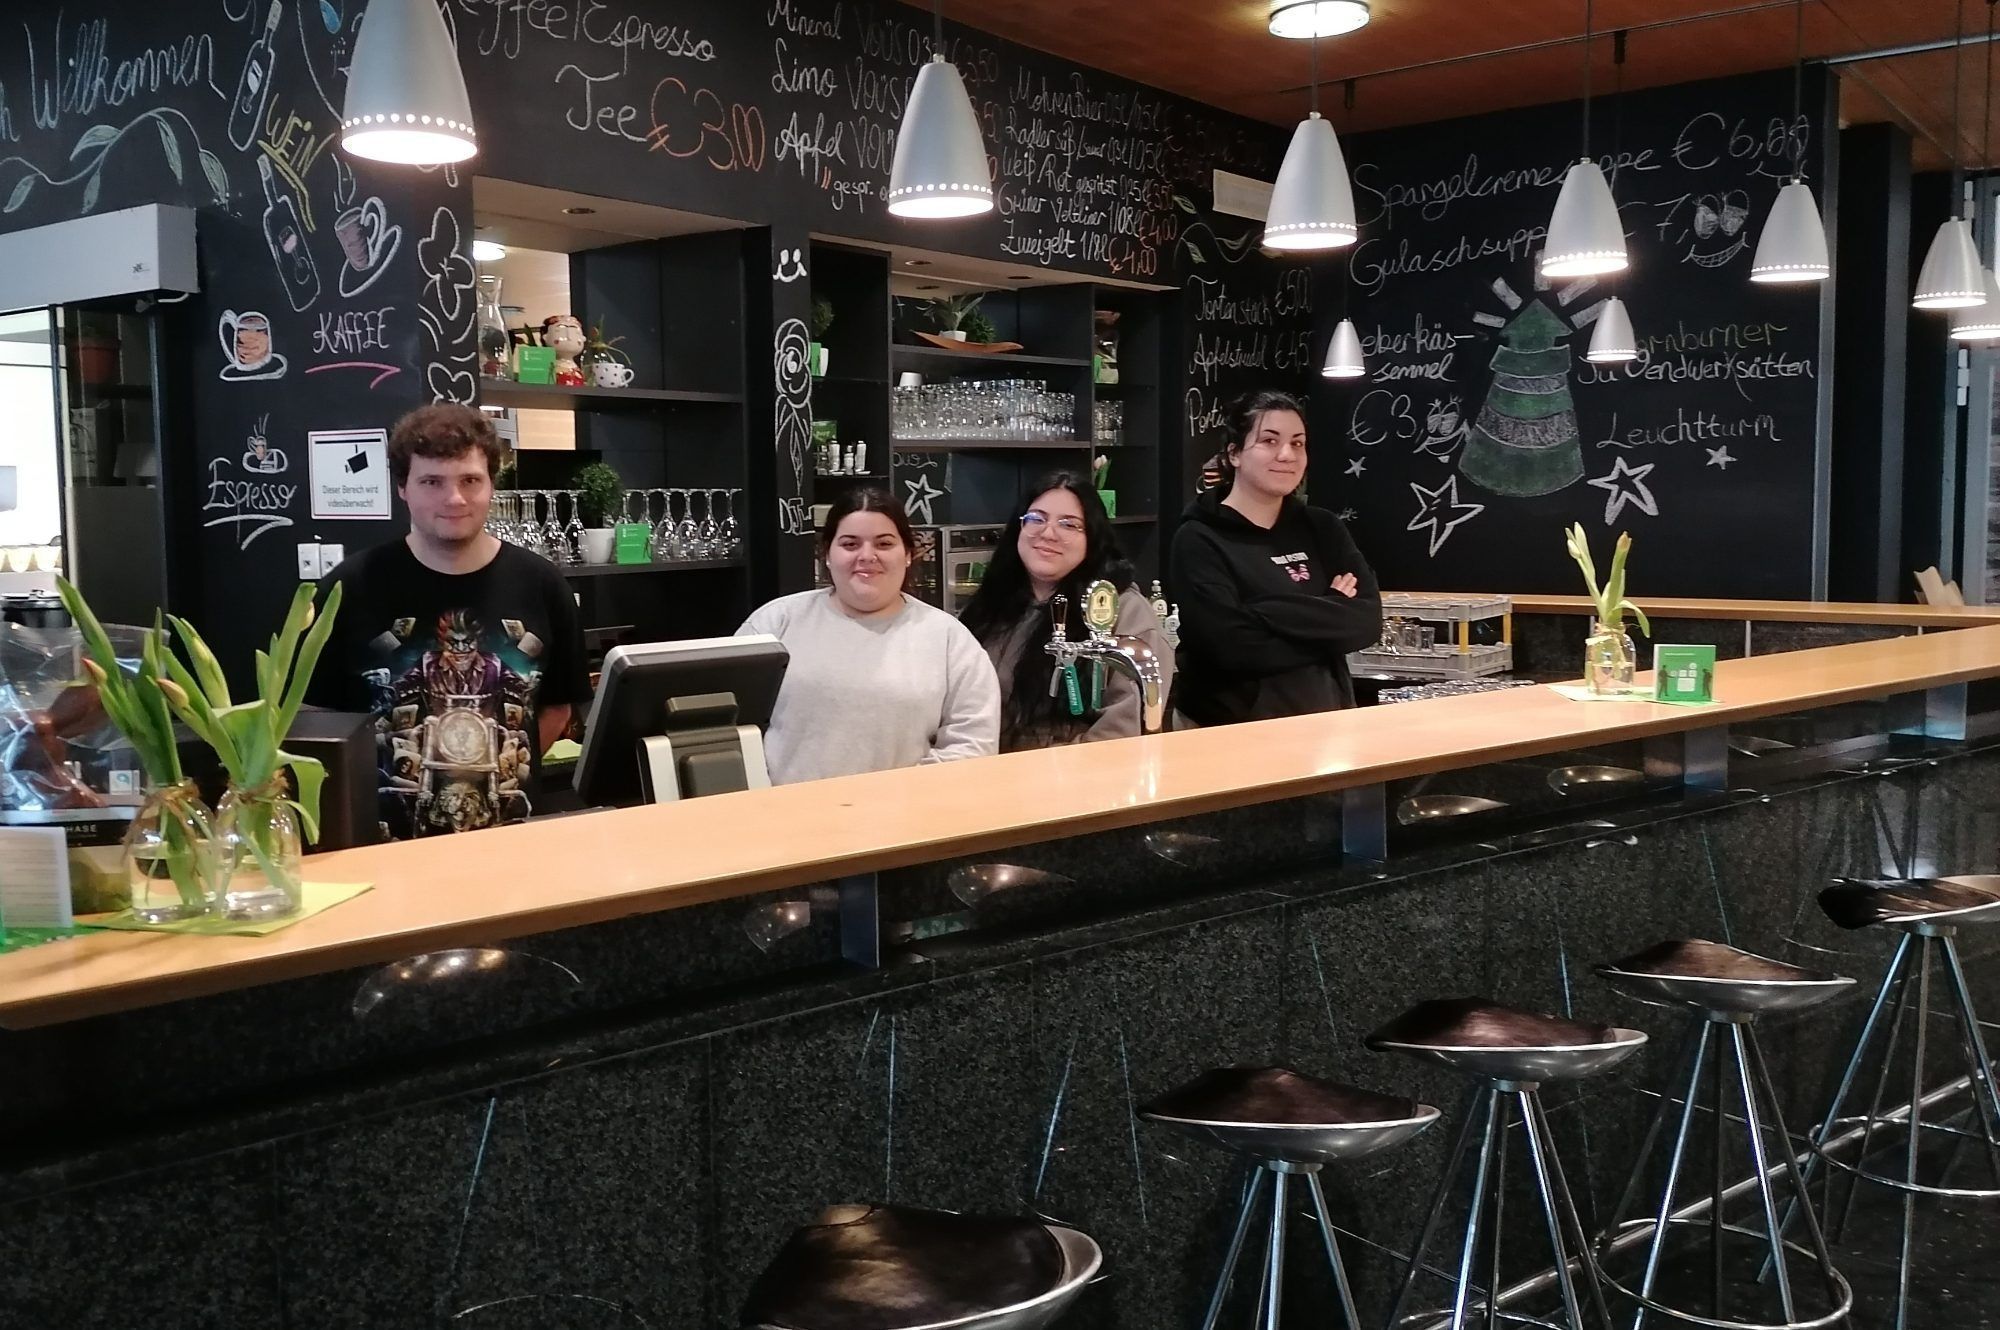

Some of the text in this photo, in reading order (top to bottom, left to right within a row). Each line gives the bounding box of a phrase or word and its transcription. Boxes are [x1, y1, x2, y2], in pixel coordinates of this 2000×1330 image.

[23, 5, 228, 130] Willkommen
[771, 37, 838, 98] Limo
[555, 64, 648, 142] Tee
[265, 92, 337, 179] WEIN
[999, 217, 1078, 266] Zweigelt
[312, 305, 396, 355] KAFFEE
[1371, 352, 1457, 384] semmel
[1595, 407, 1783, 449] Leuchtturm
[202, 456, 298, 544] Espresso
